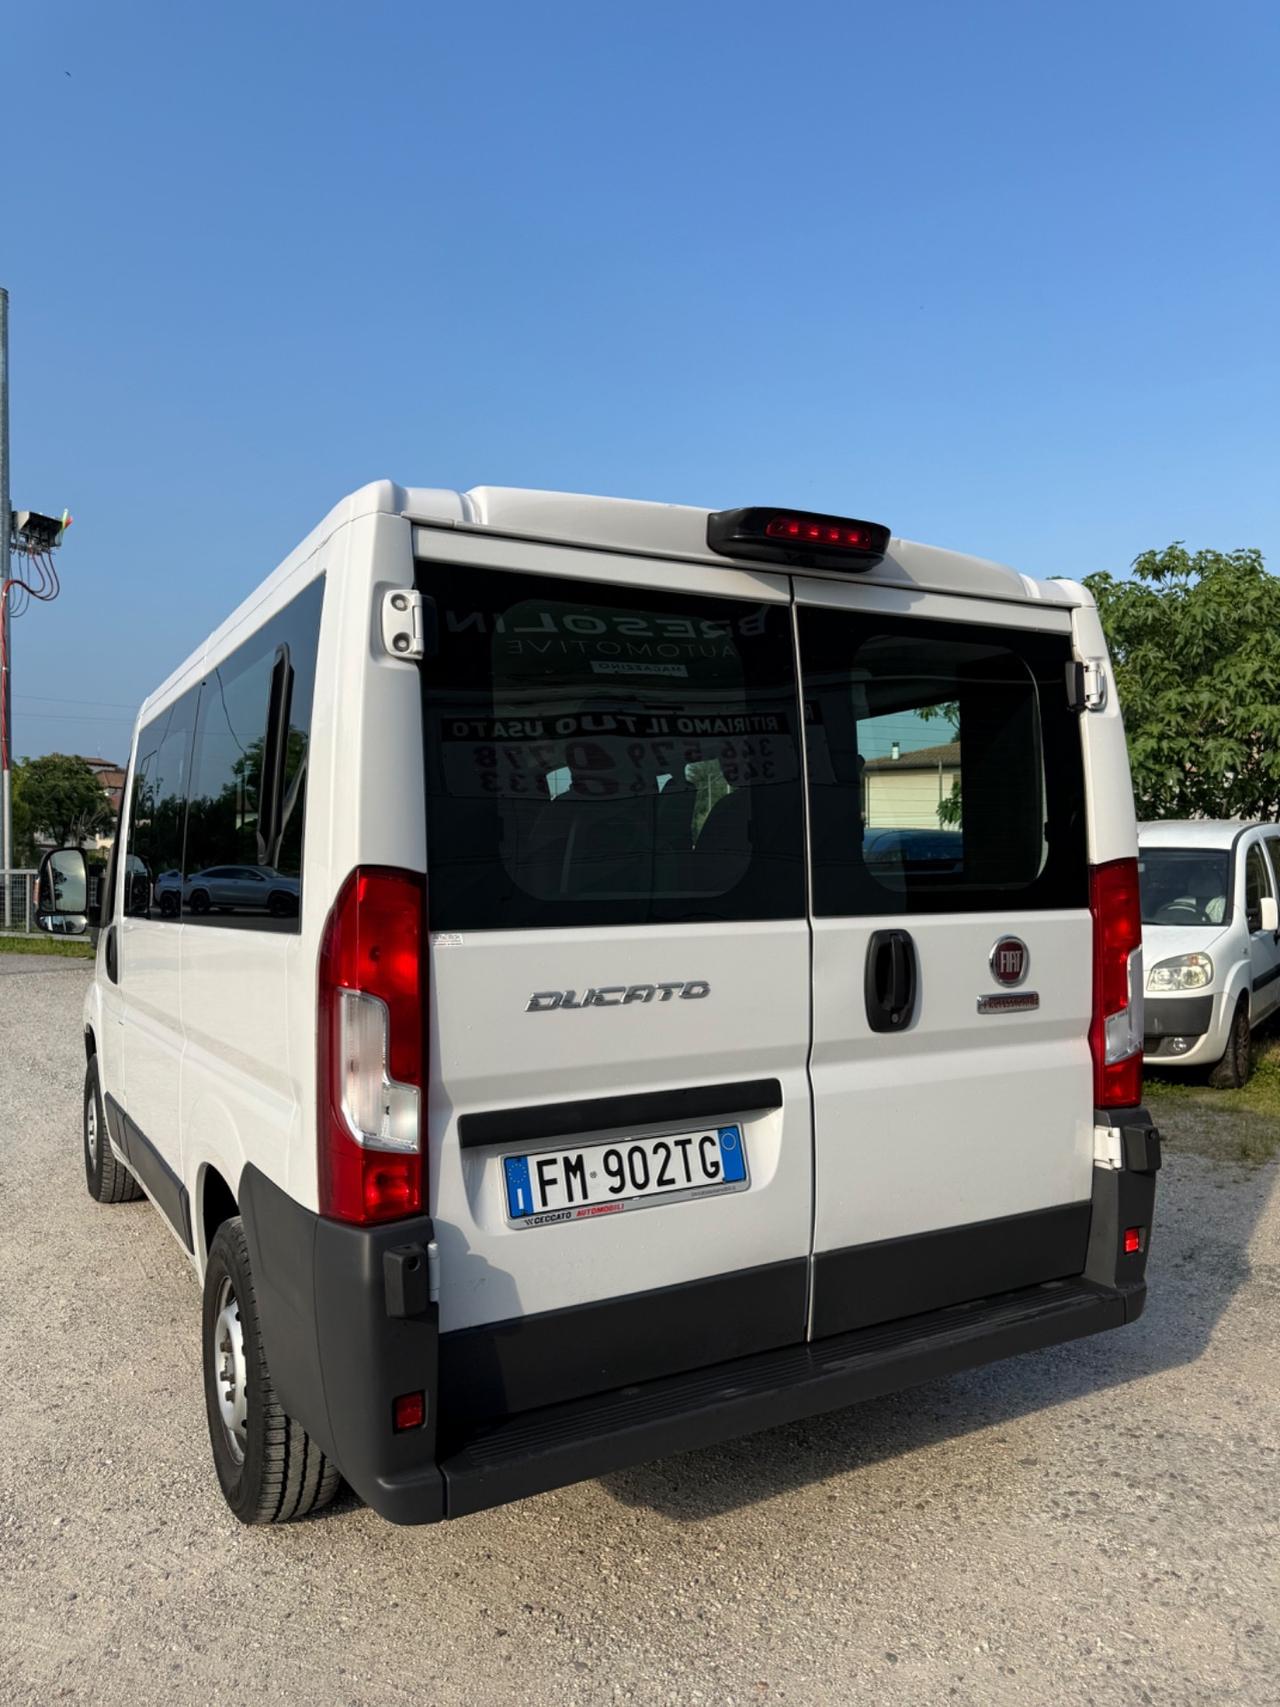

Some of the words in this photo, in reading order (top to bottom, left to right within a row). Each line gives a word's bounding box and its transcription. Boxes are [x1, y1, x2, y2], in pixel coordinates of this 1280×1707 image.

[1000, 950, 1022, 973] FIAT
[524, 980, 711, 1012] DUCATO
[517, 1188, 524, 1209] I
[534, 1211, 572, 1225] CECCATO
[576, 1203, 625, 1217] AUTOMOBILI
